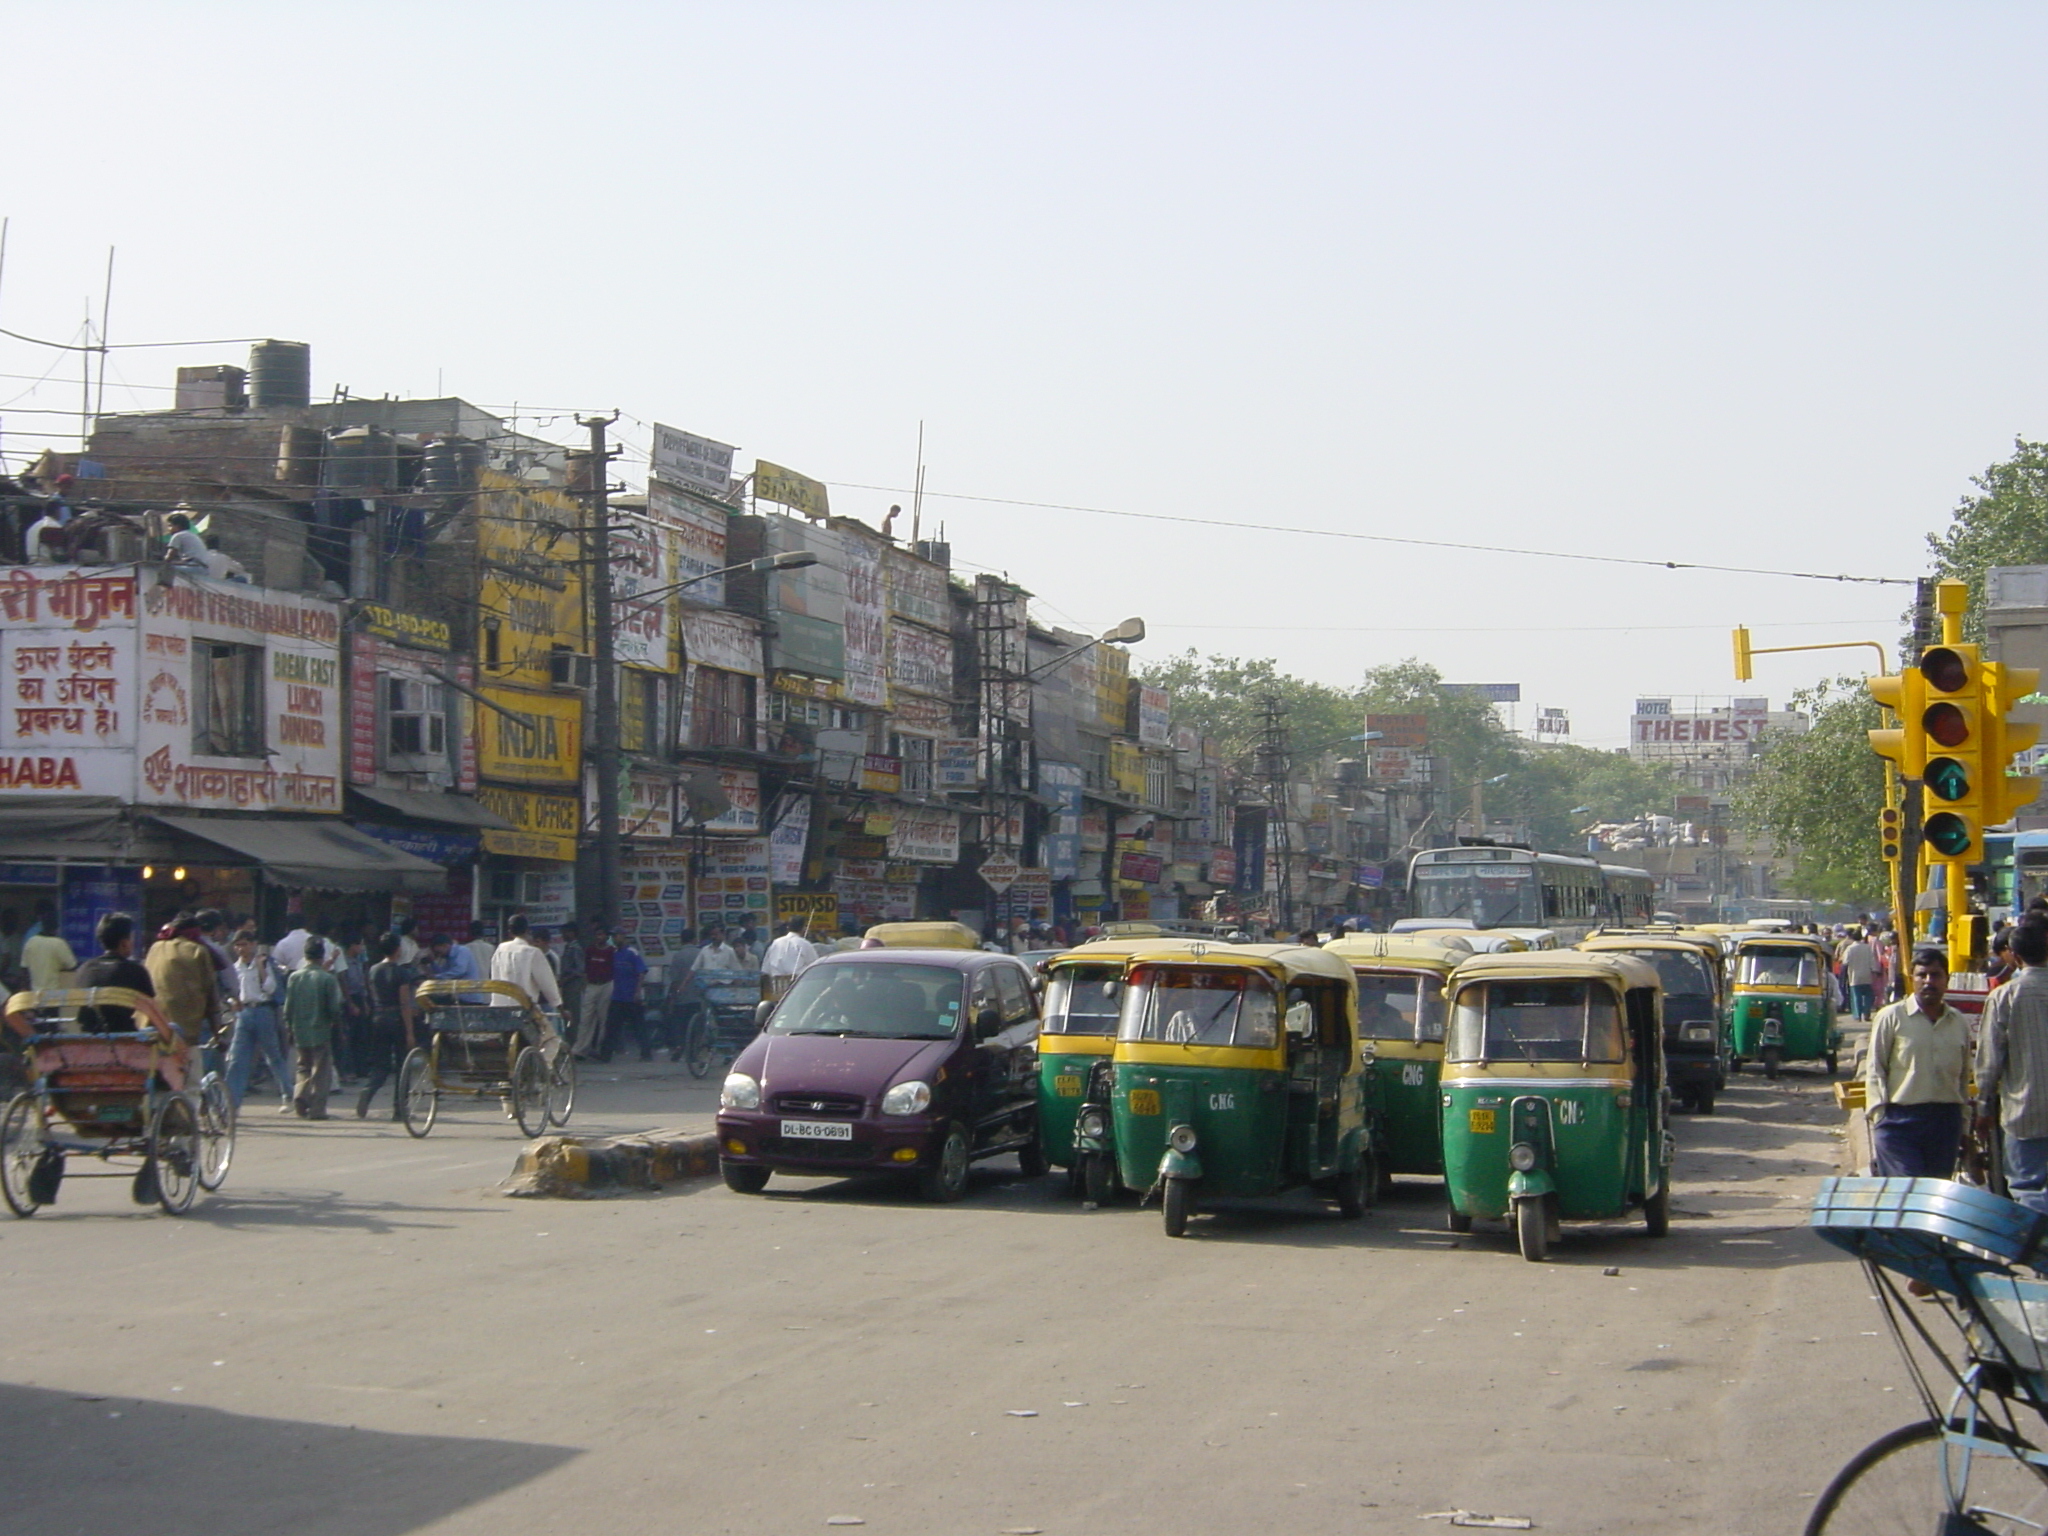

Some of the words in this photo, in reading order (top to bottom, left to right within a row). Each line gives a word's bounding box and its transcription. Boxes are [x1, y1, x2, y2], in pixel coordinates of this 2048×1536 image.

[45, 571, 136, 632] भोजन
[166, 586, 204, 622] PURE
[305, 609, 339, 642] FOOD
[13, 647, 60, 675] ऊपर
[274, 652, 308, 684] BREAK
[310, 657, 337, 688] FAST
[17, 678, 44, 703] का
[56, 673, 118, 703] उचित
[287, 684, 323, 716] LUNCH
[1636, 702, 1670, 714] HOTEL
[279, 714, 326, 747] DINNER
[499, 711, 560, 761] INDIA
[174, 760, 280, 806] शाकाहारी
[281, 763, 336, 806] भोजन
[536, 796, 576, 830] OFFICE
[1402, 1064, 1423, 1086] CNG
